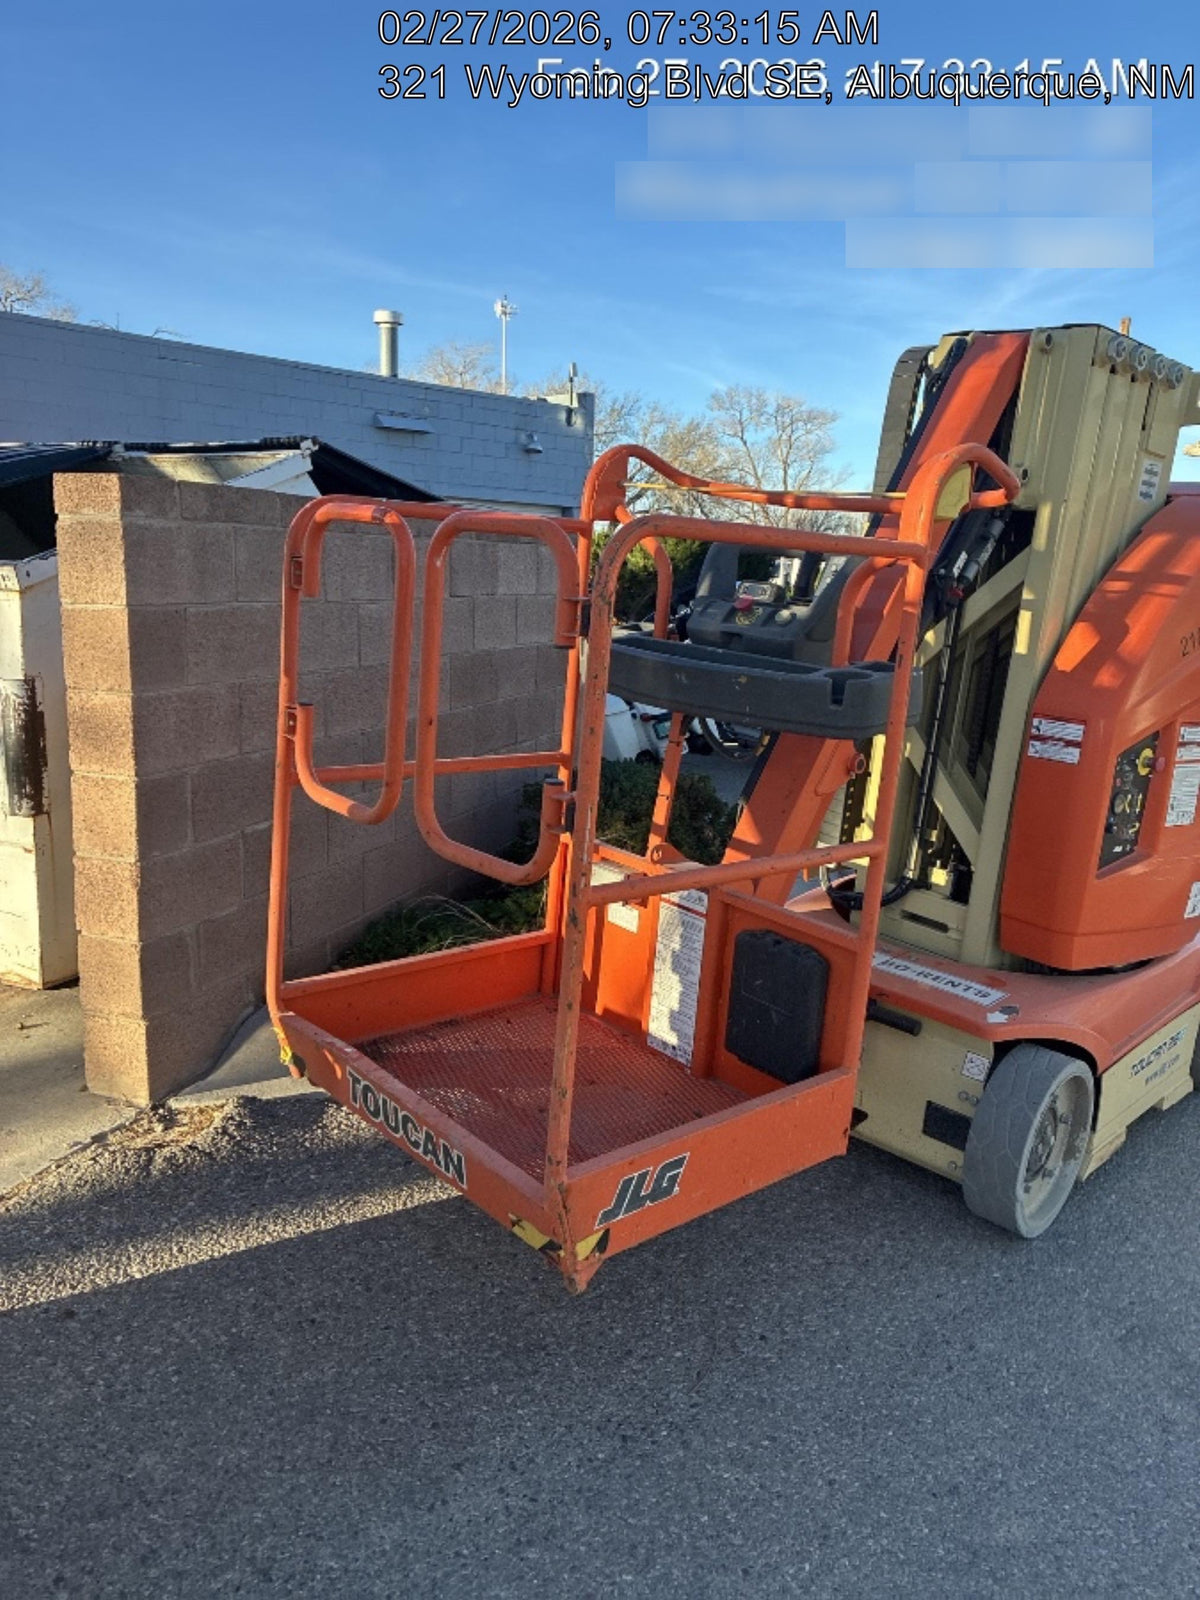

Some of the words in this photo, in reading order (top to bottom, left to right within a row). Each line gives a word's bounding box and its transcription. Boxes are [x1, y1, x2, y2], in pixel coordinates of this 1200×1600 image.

[1180, 626, 1200, 657] 21
[346, 1066, 468, 1189] TOUCAN
[594, 1152, 690, 1229] JLG
